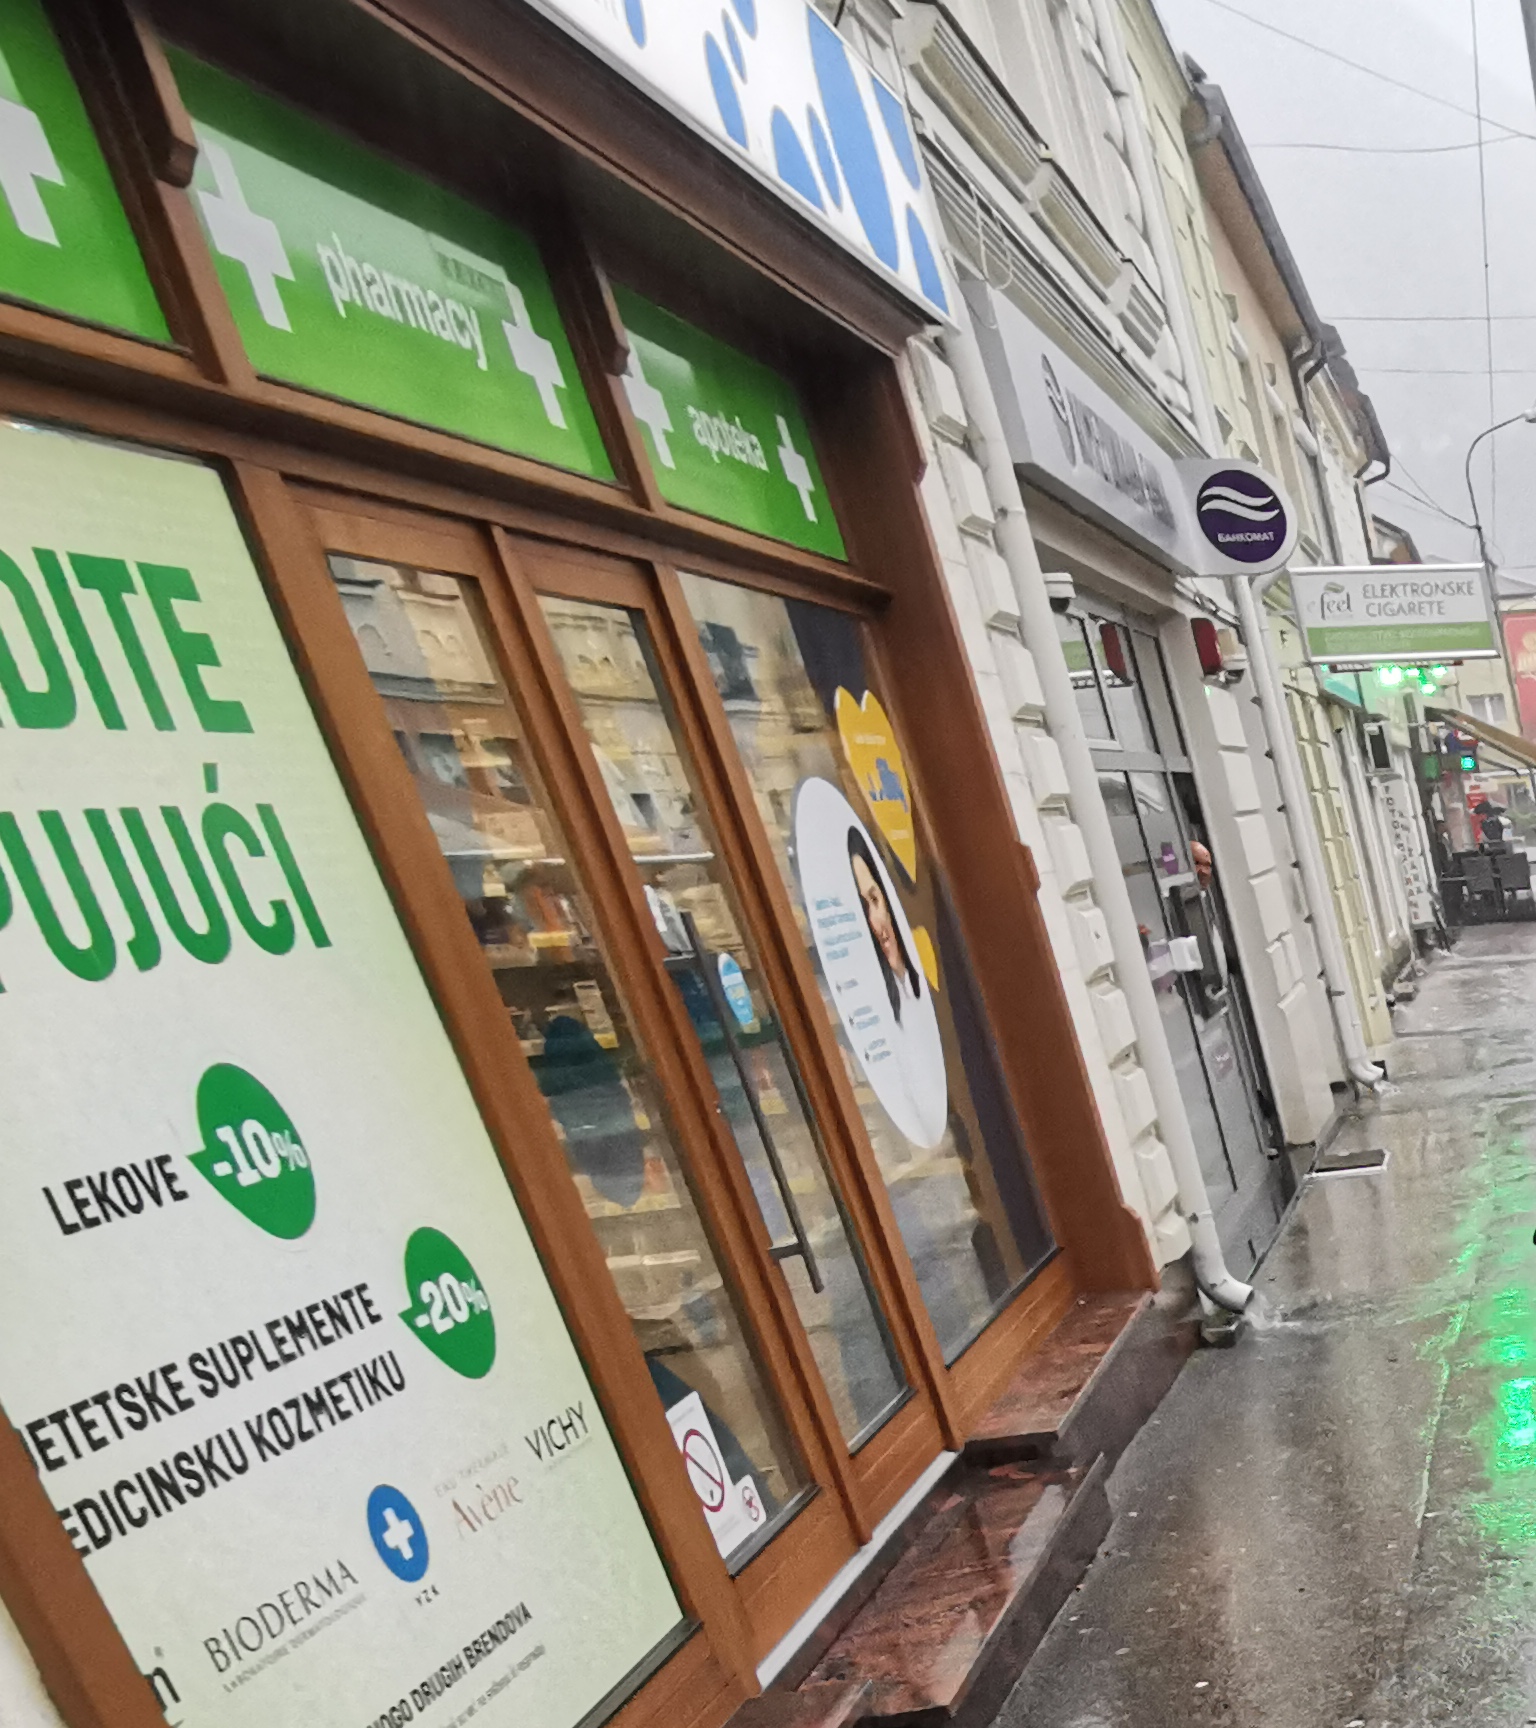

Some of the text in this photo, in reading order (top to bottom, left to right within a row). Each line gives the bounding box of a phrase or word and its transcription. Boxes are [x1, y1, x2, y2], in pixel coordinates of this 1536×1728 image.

[316, 231, 488, 371] pharmacy
[685, 404, 770, 473] apoteka
[1217, 531, 1275, 543] БАНКОМАТ
[1320, 592, 1353, 620] feel
[1362, 580, 1475, 600] ELEKTRONSKE
[1365, 600, 1446, 618] CIGARETE
[42, 1118, 308, 1237] LEKOVE -10%
[20, 1272, 489, 1473] ETETSKE SUPLEMENTE -20%
[244, 1350, 406, 1463] KOZMETIKU
[524, 1400, 588, 1461] VICHY
[202, 1559, 359, 1673] BIODERMA
[408, 1653, 468, 1713] DRUGIH
[462, 1601, 533, 1670] BRENDOVA
